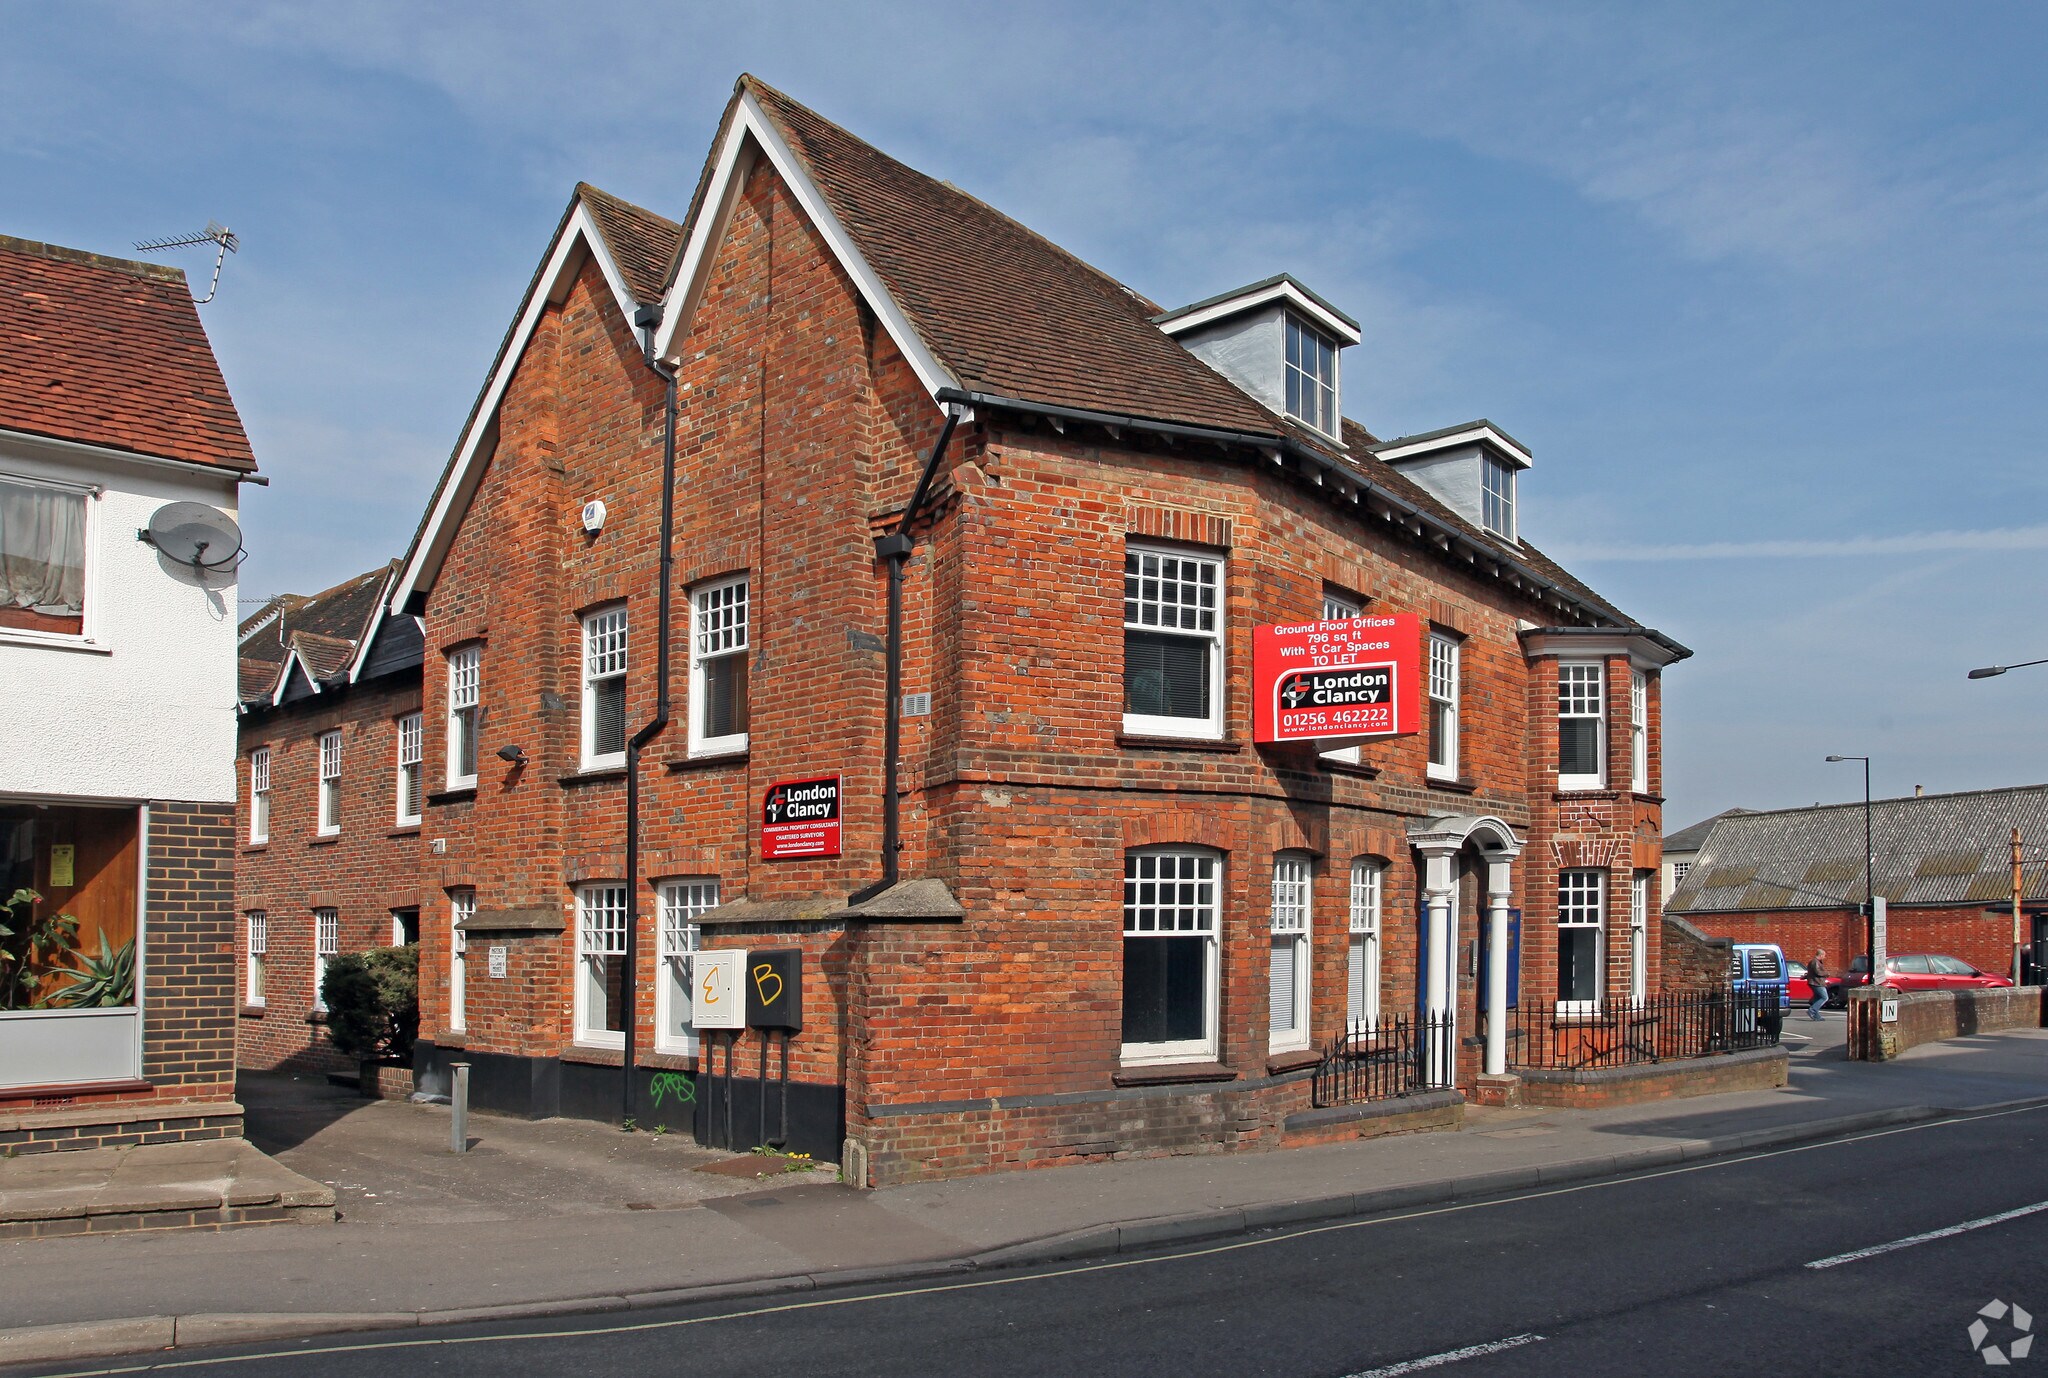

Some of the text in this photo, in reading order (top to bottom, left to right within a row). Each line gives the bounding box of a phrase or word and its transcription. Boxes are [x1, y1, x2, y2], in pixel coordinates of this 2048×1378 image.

[1274, 617, 1395, 635] Ground Floor Offices
[1307, 631, 1361, 643] 796 sq ft
[1280, 641, 1390, 656] With 5 Car Spaces
[1312, 653, 1357, 666] TO LET
[1313, 673, 1387, 690] London
[1313, 689, 1379, 704] Clancy
[1283, 709, 1388, 726] 01256 462222
[1283, 721, 1388, 732] www.londonclancy.com
[787, 785, 836, 802] London
[786, 803, 831, 818] Clancy
[763, 821, 839, 833] COMMERCIAL PROPERTY CONSULTANTS
[776, 833, 799, 841] CHARTERED
[1885, 1004, 1895, 1017] IN
